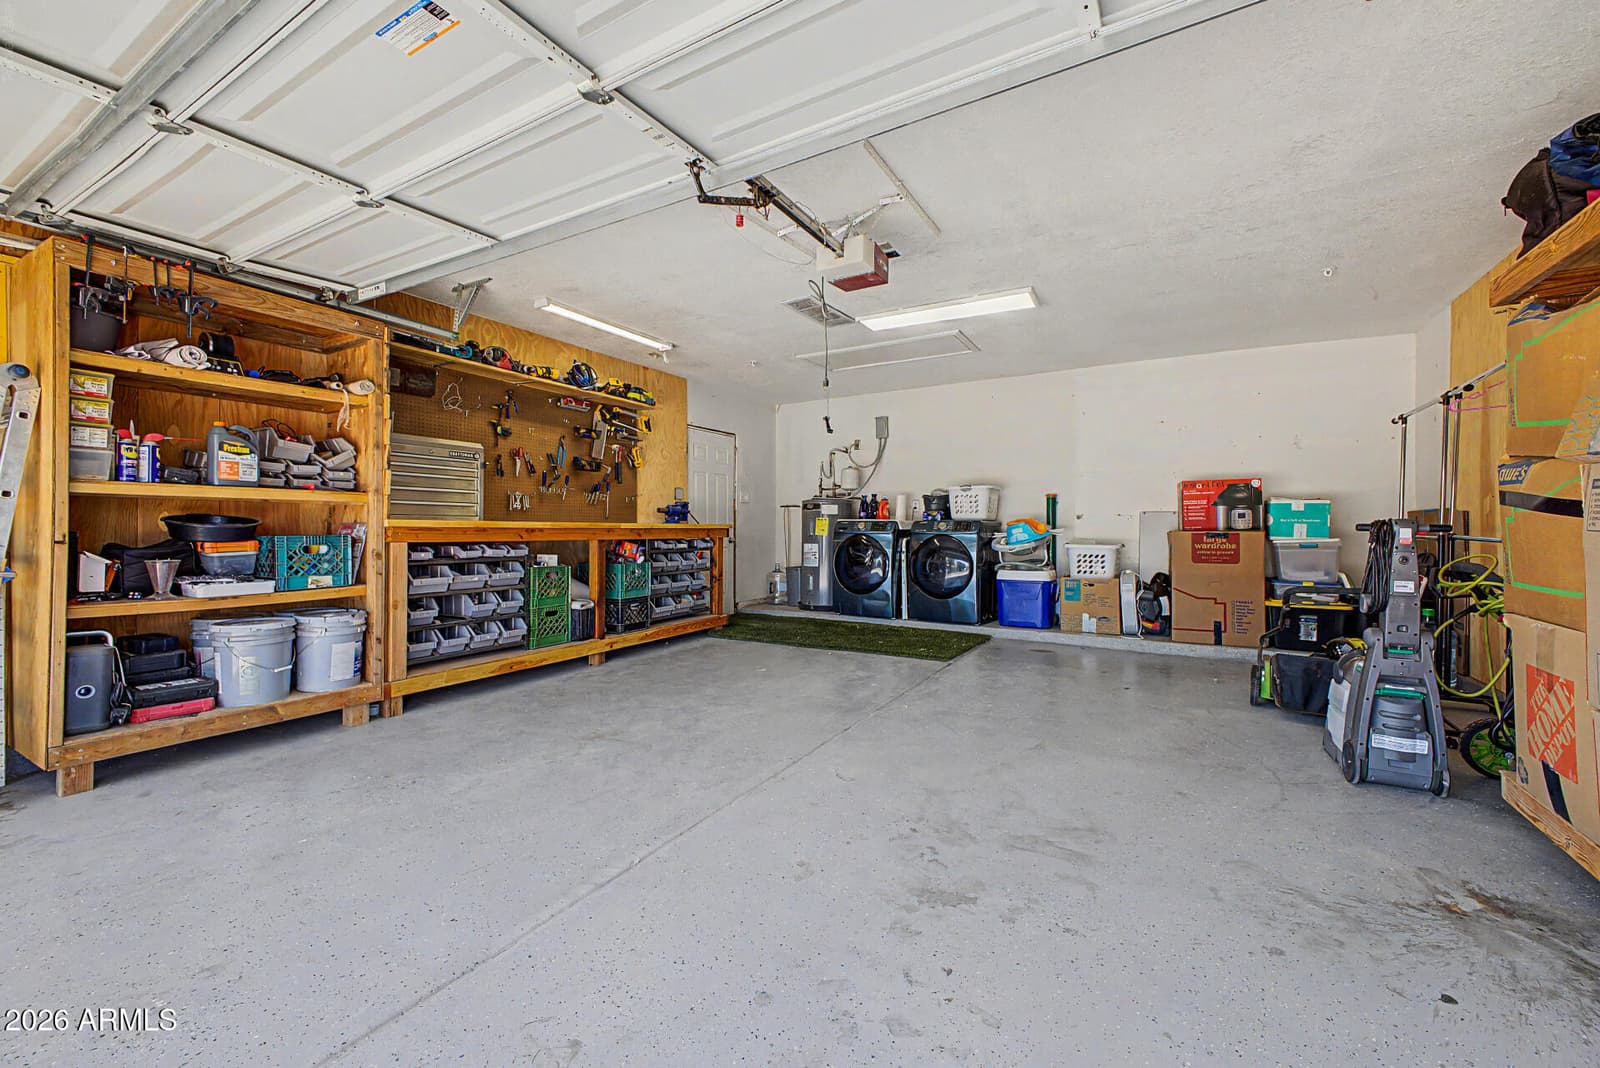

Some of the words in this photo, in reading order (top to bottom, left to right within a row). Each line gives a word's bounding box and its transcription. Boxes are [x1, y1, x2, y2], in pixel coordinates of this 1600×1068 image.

[1526, 678, 1575, 760] HOME
[1529, 680, 1549, 713] THE
[1543, 715, 1577, 768] DEPOT
